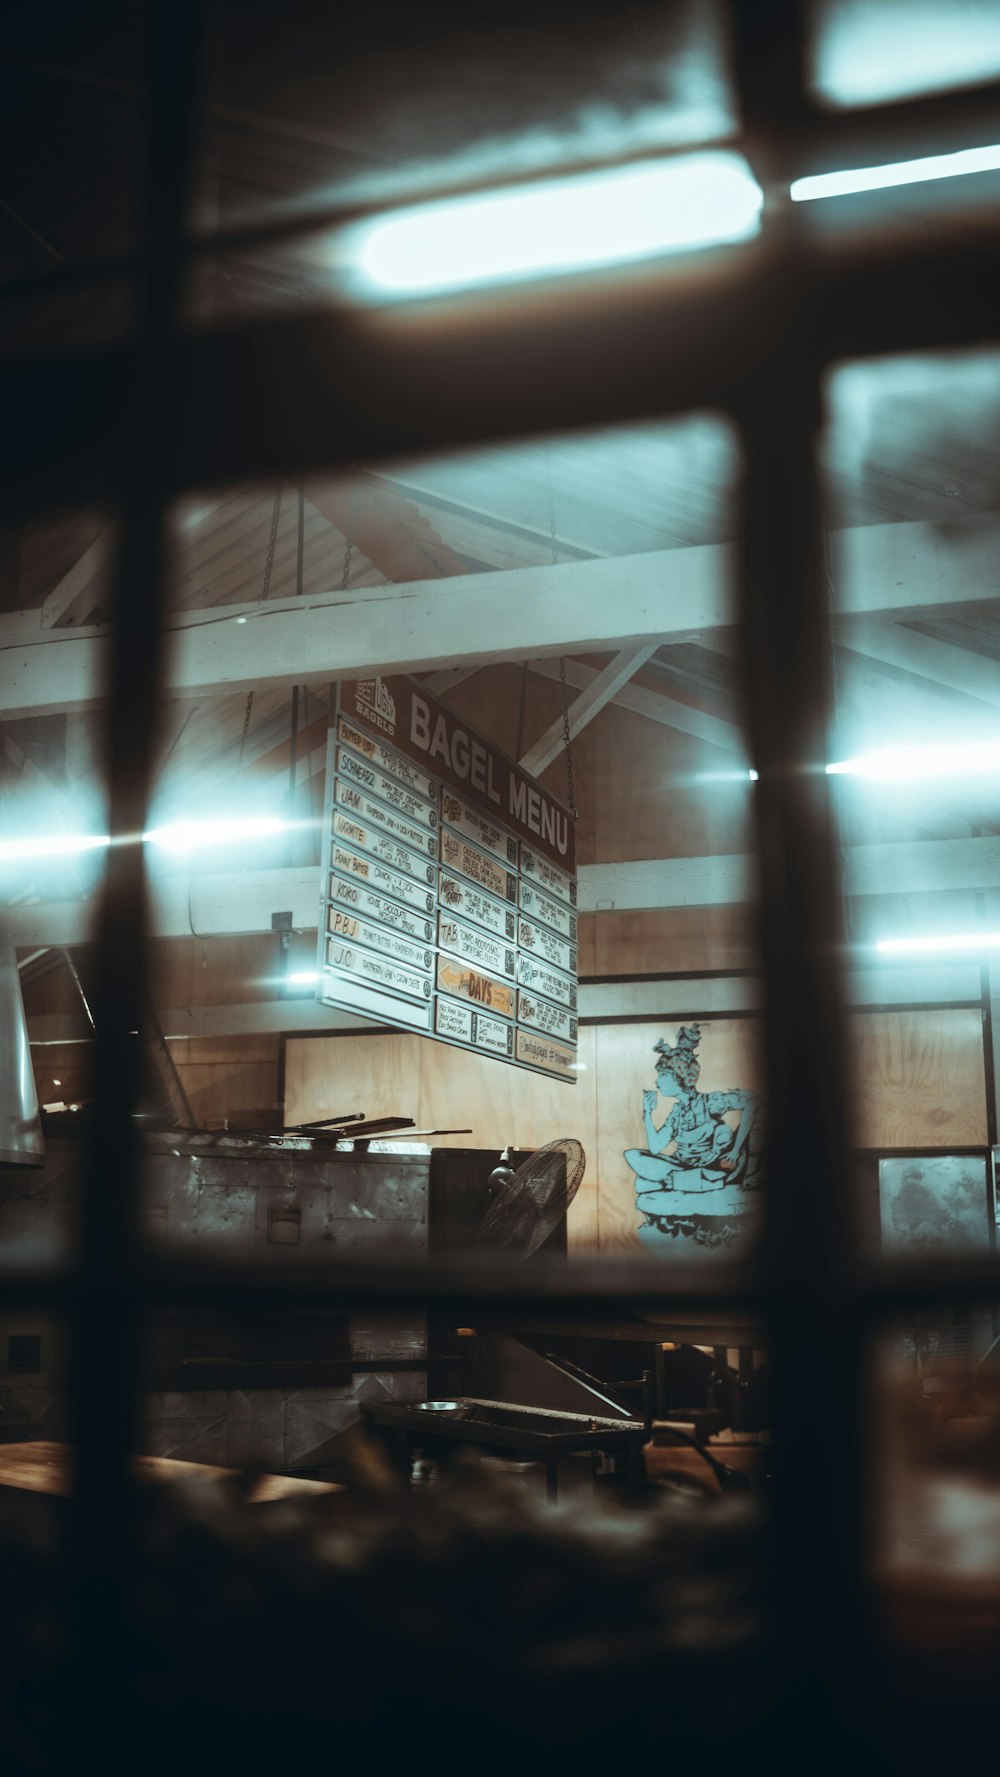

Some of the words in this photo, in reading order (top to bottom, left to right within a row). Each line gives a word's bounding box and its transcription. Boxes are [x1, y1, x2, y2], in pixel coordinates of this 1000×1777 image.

[357, 682, 376, 706] BEST
[376, 677, 396, 722] UGLY
[356, 701, 395, 736] BAGELS
[410, 693, 501, 805] BAGEL
[509, 771, 568, 855] MENU
[342, 787, 360, 810] JAM
[406, 795, 423, 812] ORGANIC
[337, 882, 358, 903] KOKO
[384, 903, 406, 920] CHOCOLATE
[442, 920, 458, 945] TAB
[470, 973, 493, 1005] DAYS
